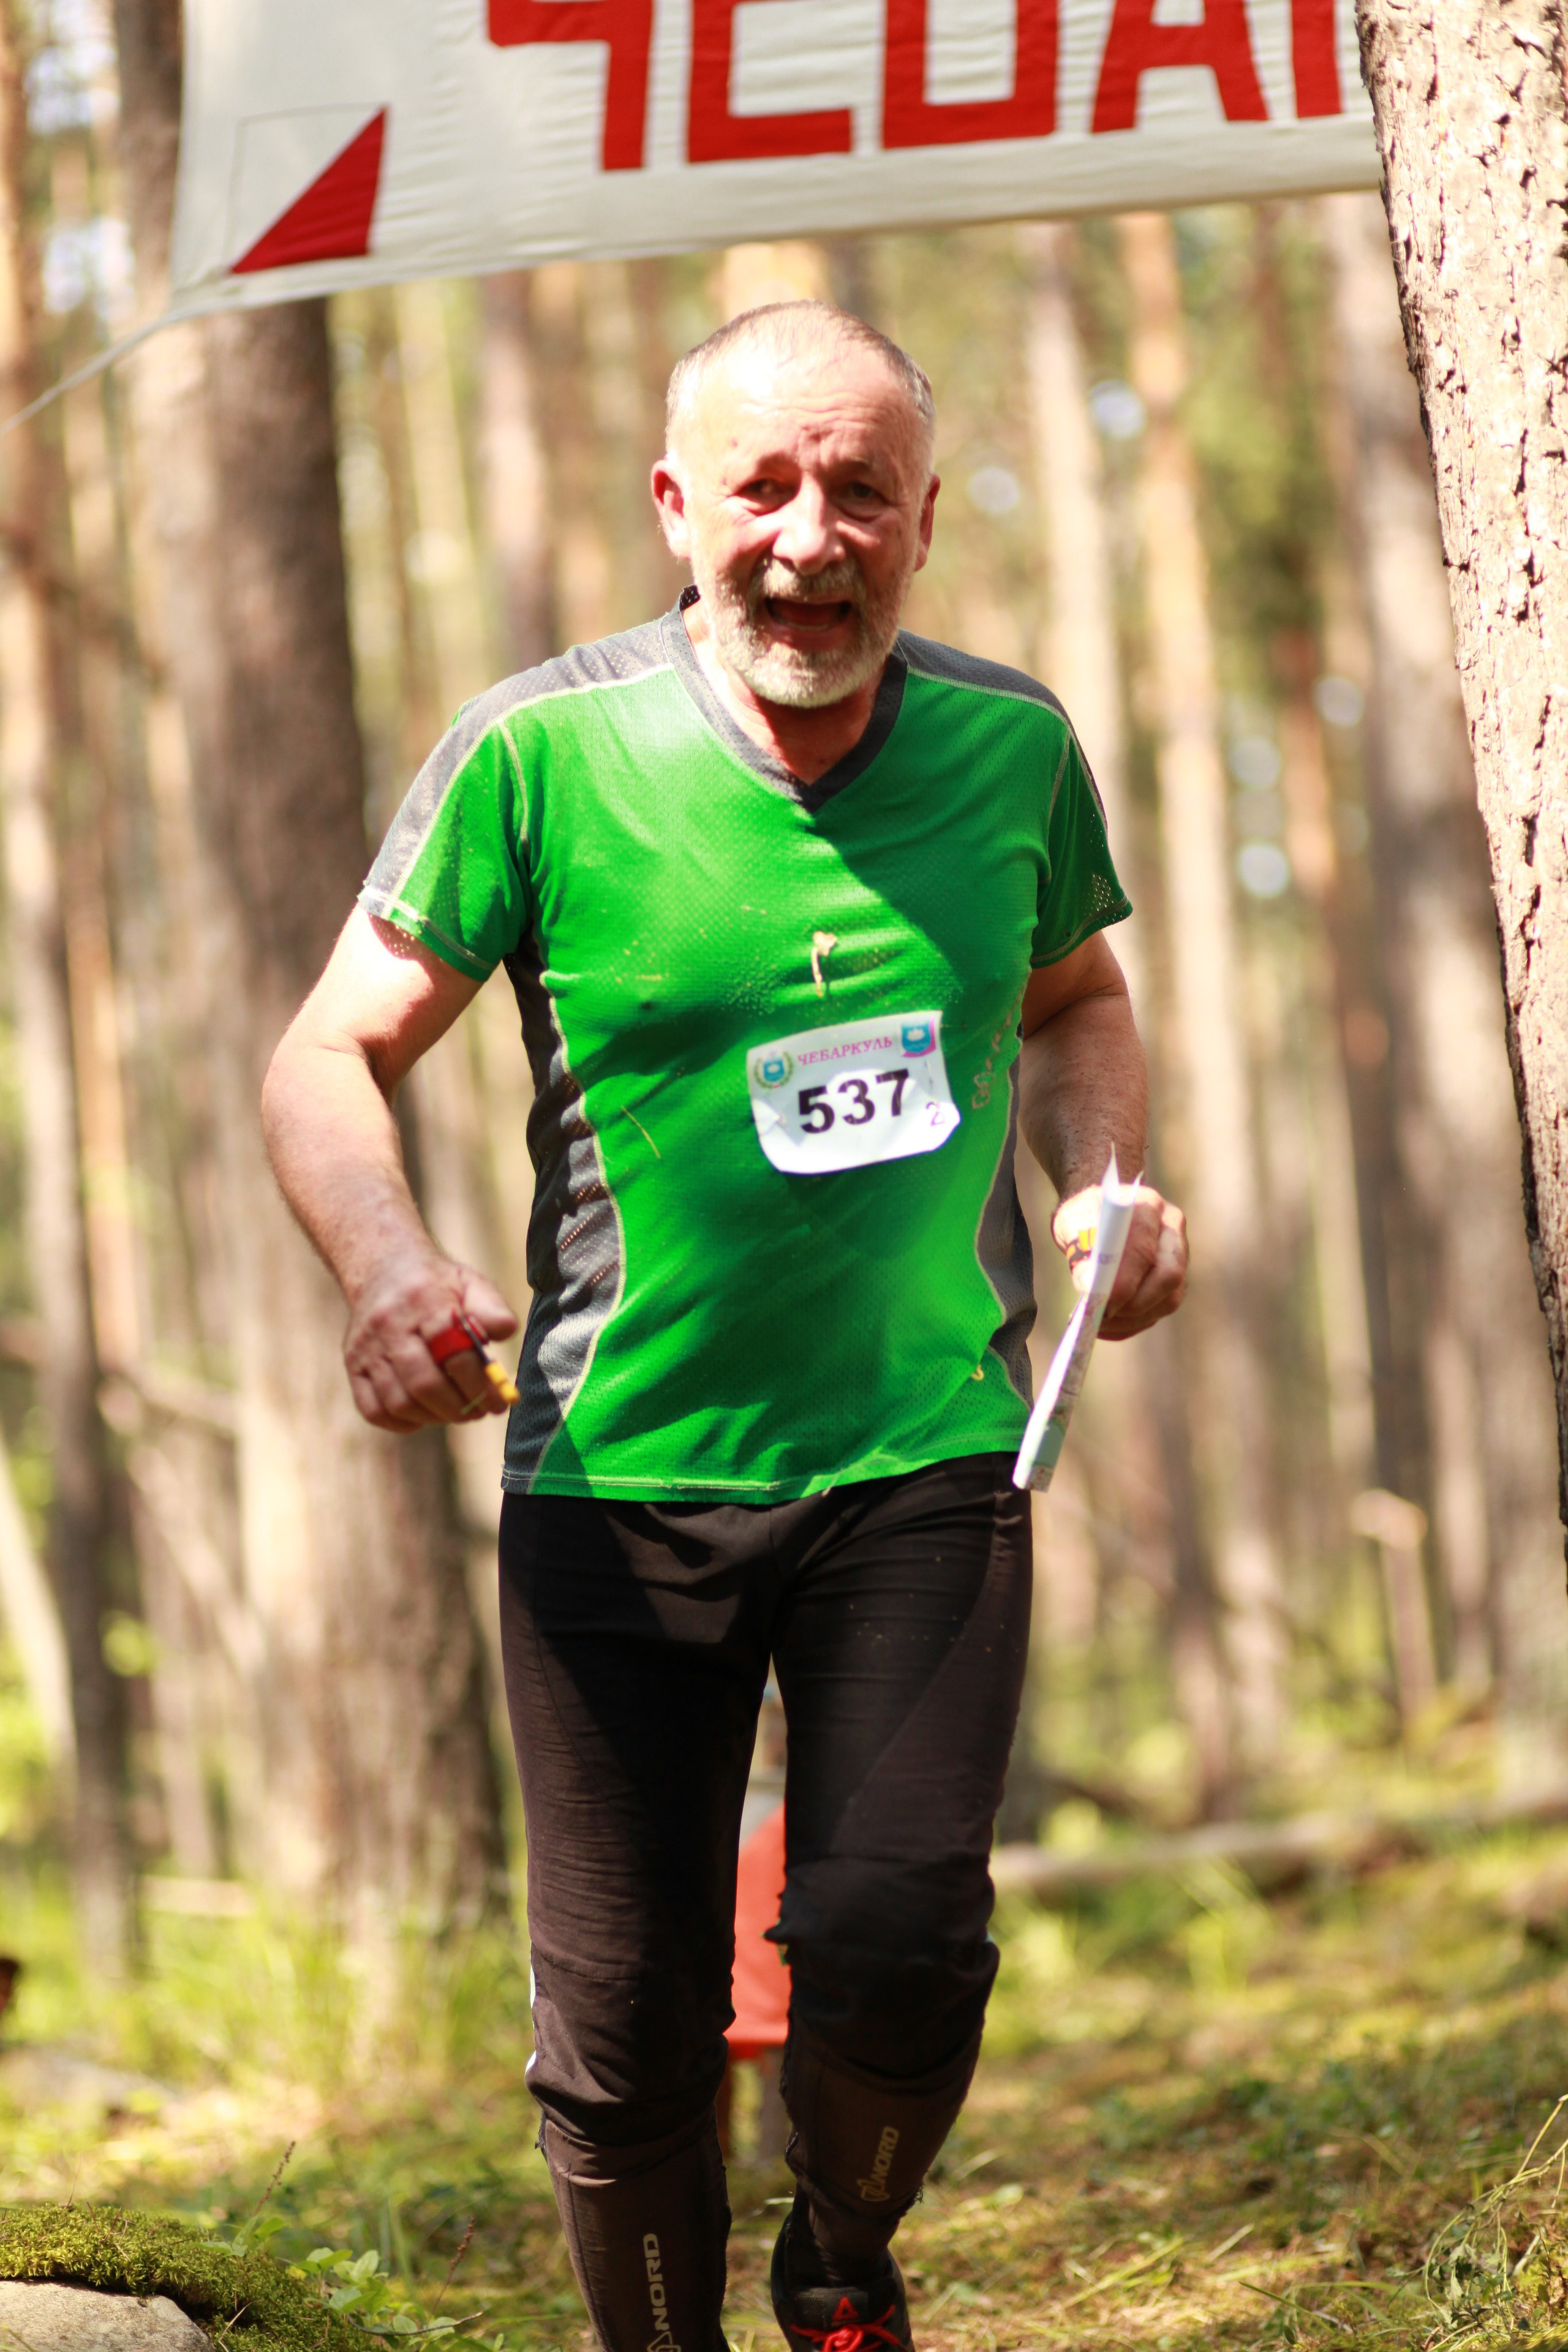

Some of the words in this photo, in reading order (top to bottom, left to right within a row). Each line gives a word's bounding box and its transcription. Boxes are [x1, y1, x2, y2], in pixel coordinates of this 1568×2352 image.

[797, 1036, 892, 1065] ЧЕБАРКУЛЬ
[798, 1068, 910, 1134] 537
[643, 2233, 670, 2331] NORD
